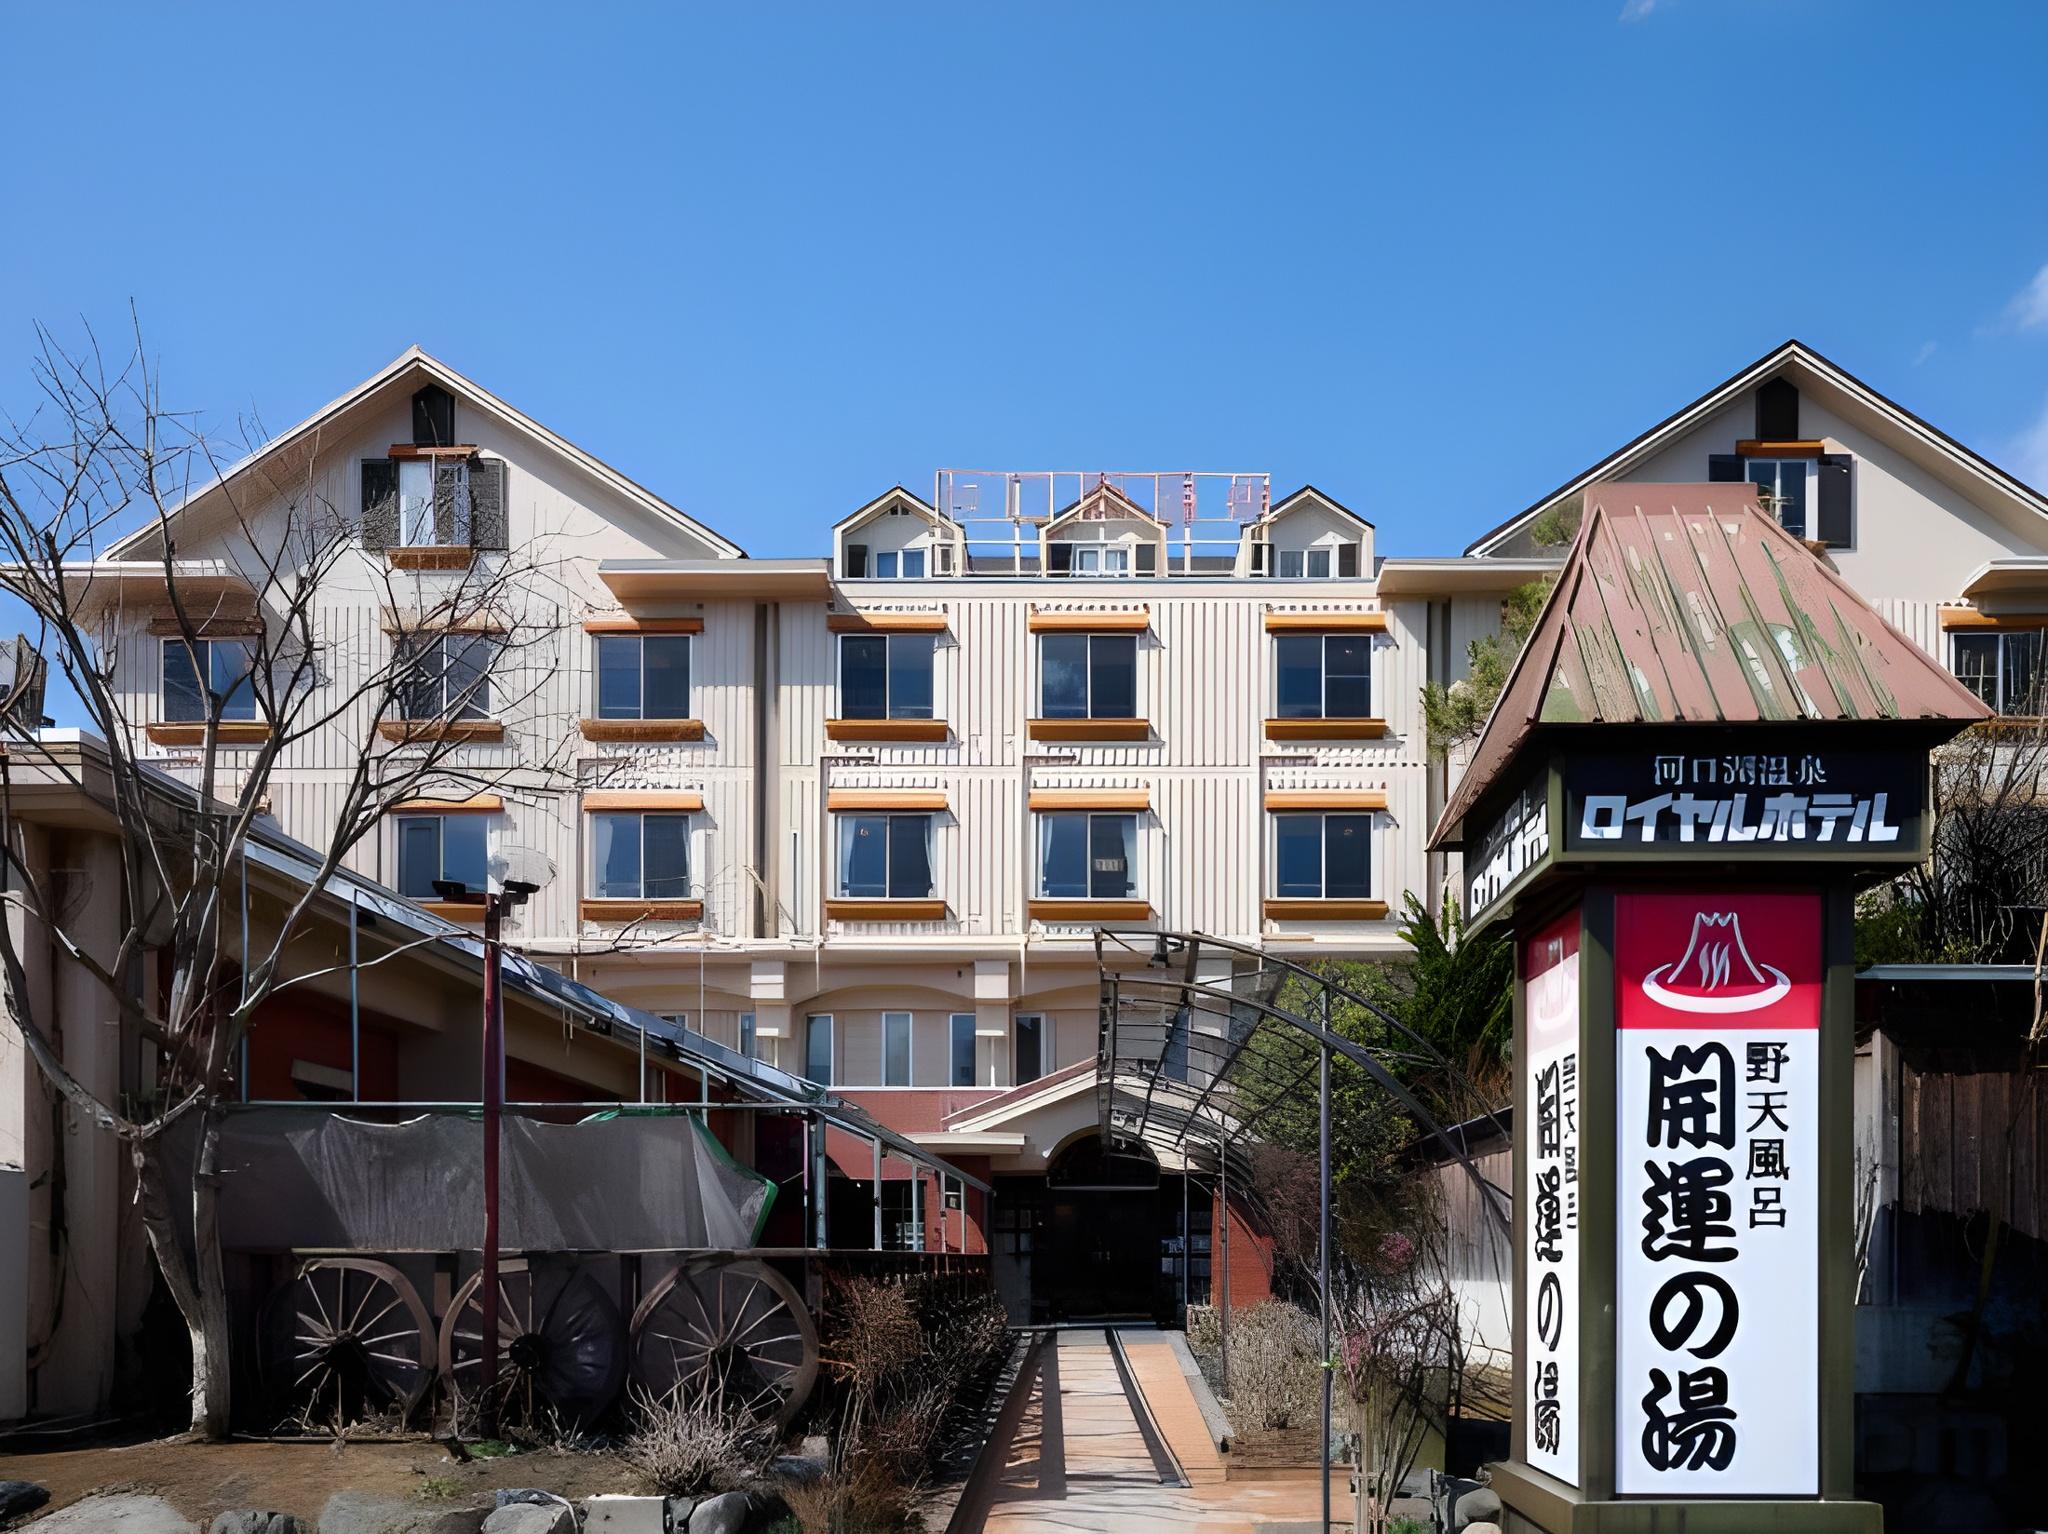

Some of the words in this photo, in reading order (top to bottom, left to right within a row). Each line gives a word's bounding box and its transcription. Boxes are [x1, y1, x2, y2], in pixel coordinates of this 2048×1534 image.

[1580, 792, 1900, 843] ロイヤルホテル
[1745, 1041, 1790, 1229] 野天風呂
[1641, 1041, 1739, 1472] 開運の湯
